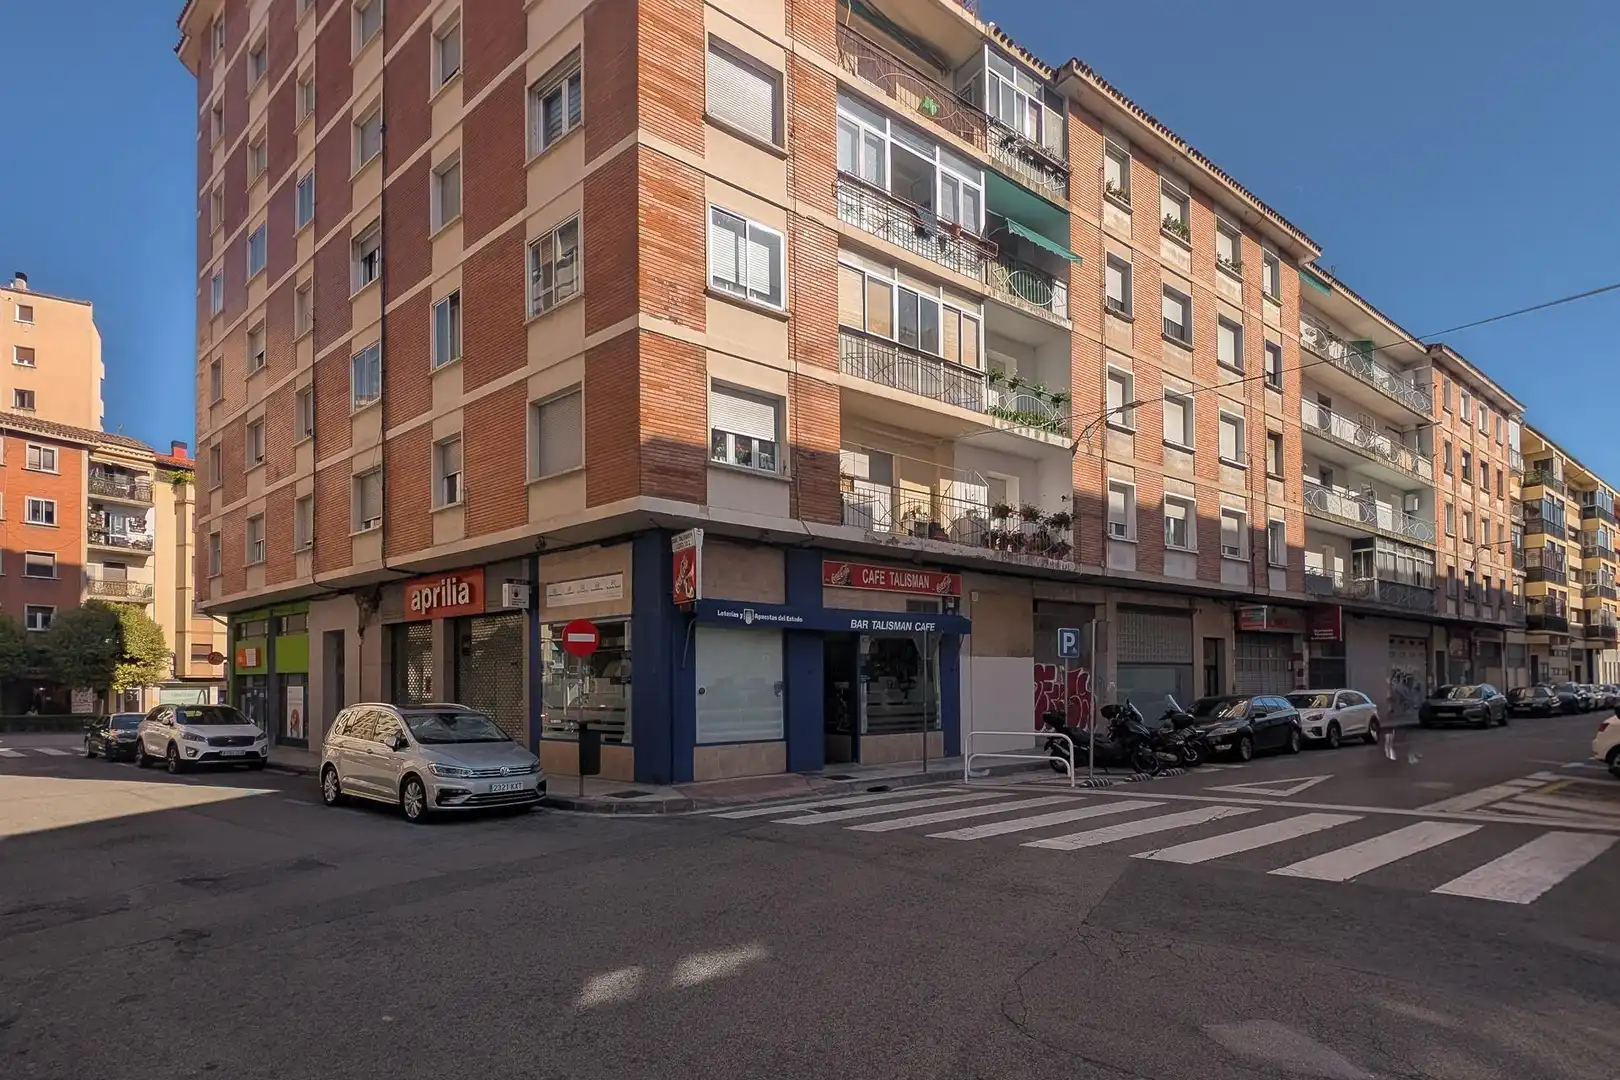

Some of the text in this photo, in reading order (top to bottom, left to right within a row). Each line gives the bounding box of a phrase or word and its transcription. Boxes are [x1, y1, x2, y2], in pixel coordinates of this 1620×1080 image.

[862, 568, 886, 585] CAFE
[889, 571, 930, 589] TALISMAN
[411, 577, 470, 615] aprilia
[754, 613, 778, 621] Apuestas
[786, 615, 804, 623] Estado
[850, 619, 936, 632] BAR TALISMAN CAFE
[1063, 632, 1076, 654] P
